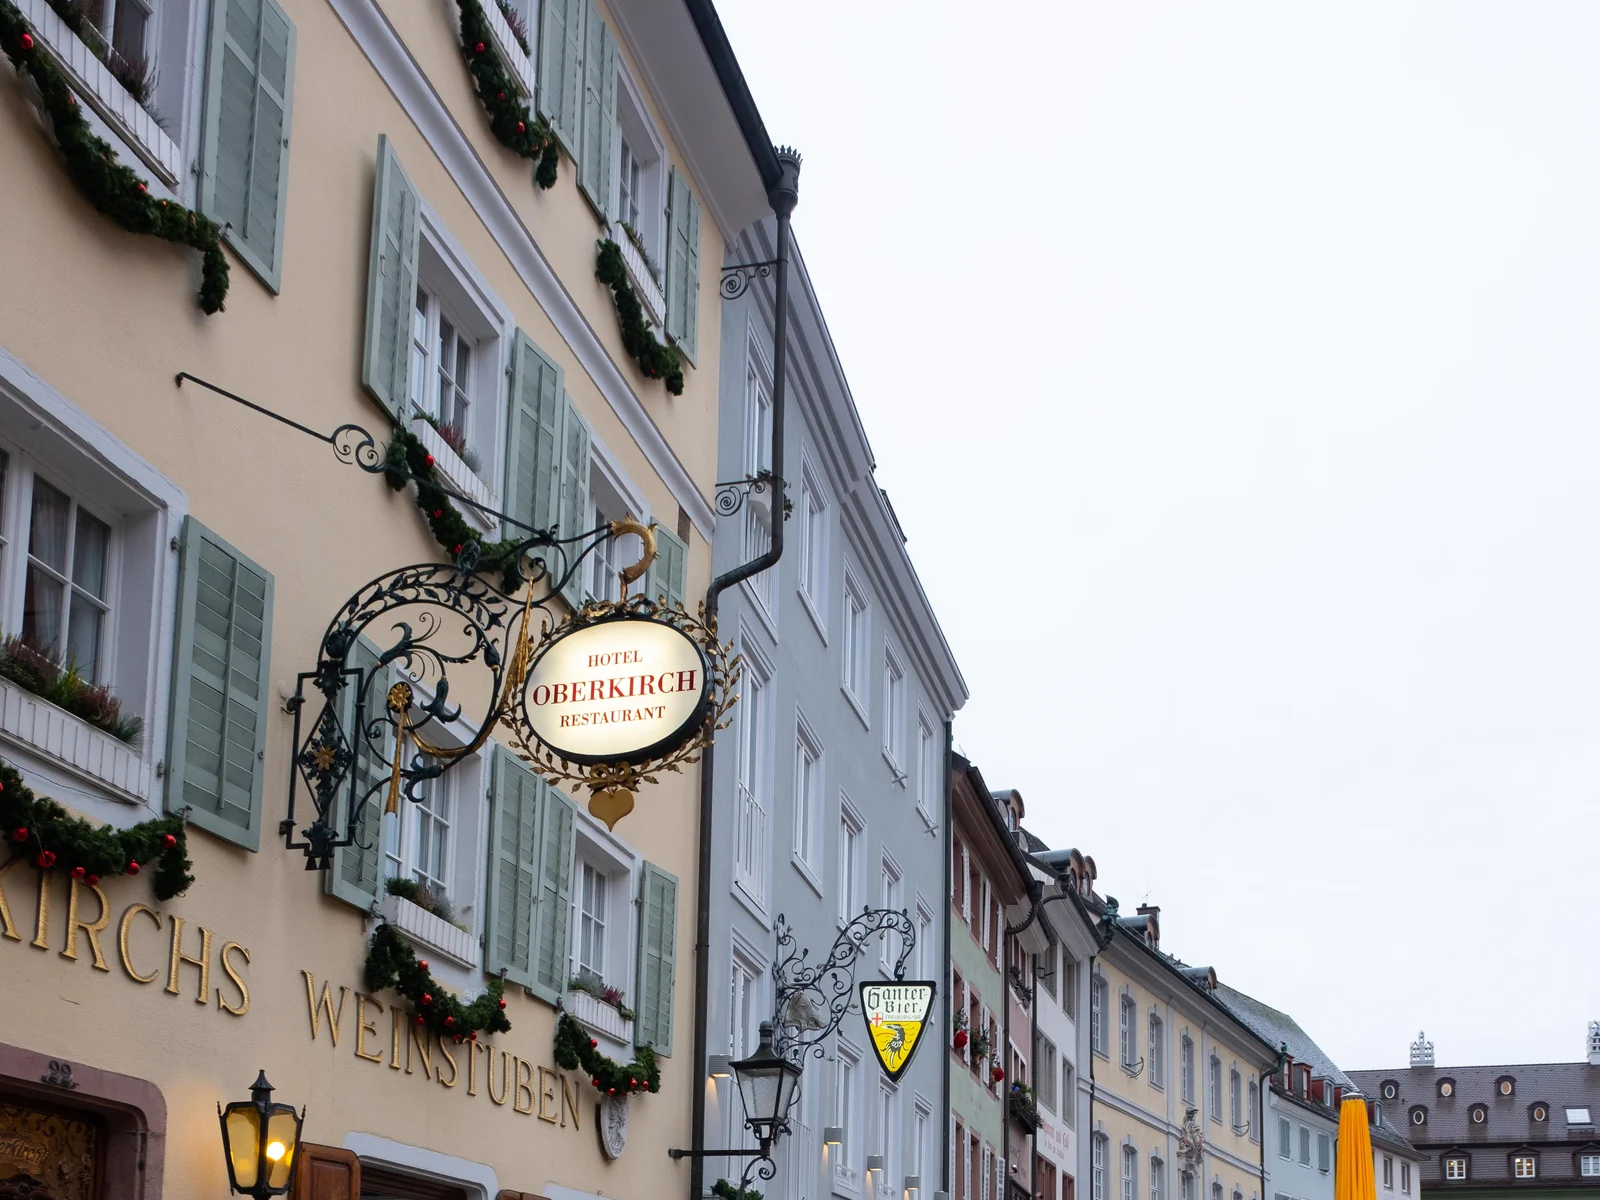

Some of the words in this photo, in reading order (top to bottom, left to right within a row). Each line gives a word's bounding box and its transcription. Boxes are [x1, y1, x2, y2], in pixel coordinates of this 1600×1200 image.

[587, 650, 643, 668] HOTEL
[532, 669, 698, 706] OBERKIRCH
[558, 705, 666, 728] RESTAURANT
[300, 969, 581, 1131] WEINSTUBEN
